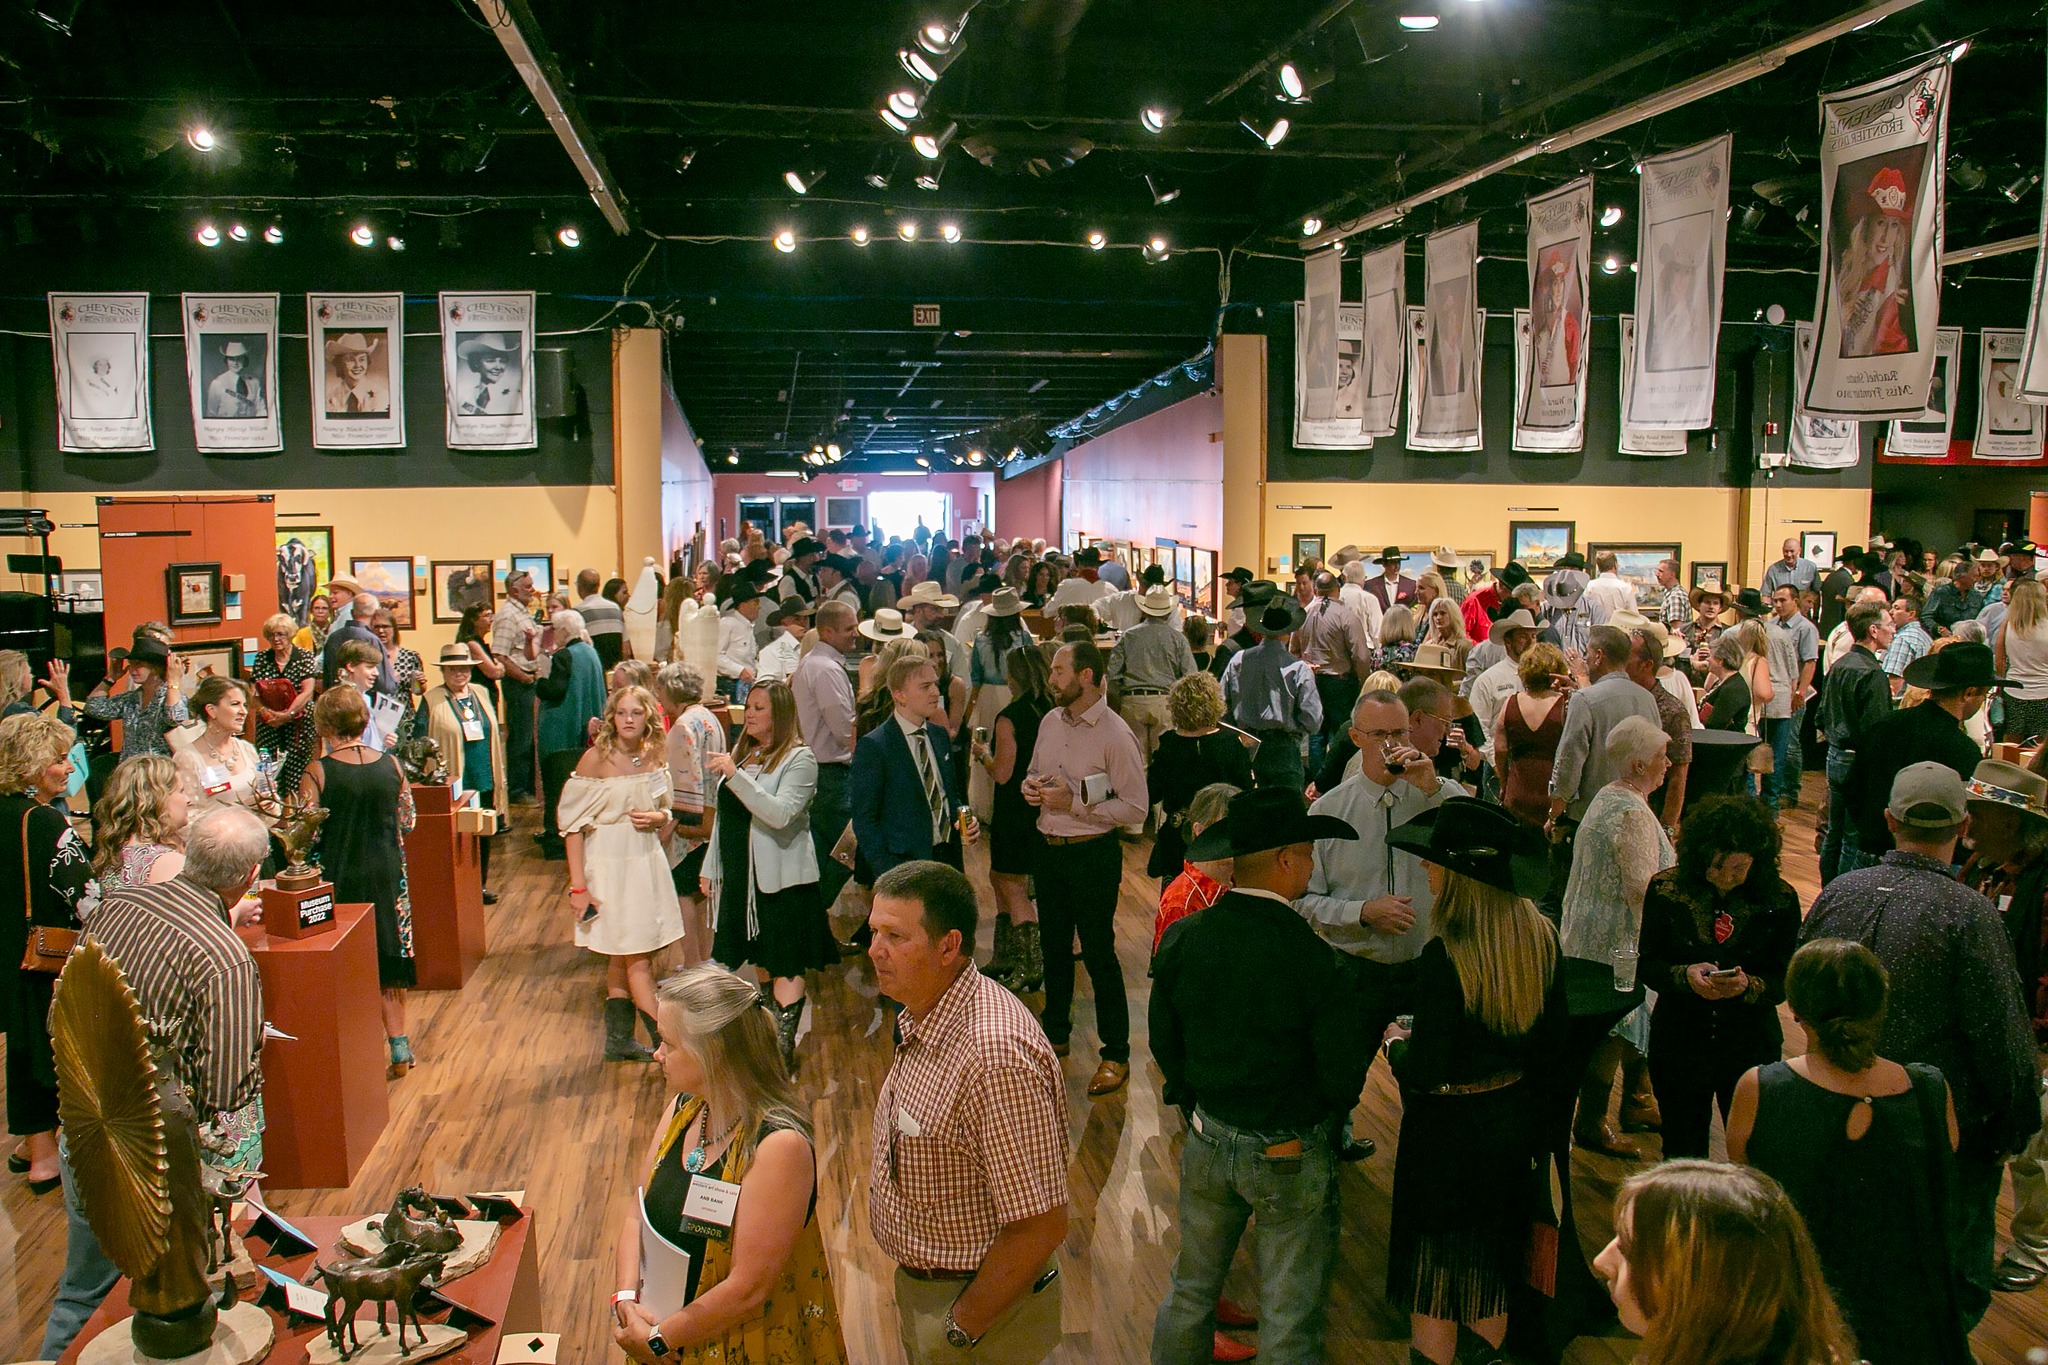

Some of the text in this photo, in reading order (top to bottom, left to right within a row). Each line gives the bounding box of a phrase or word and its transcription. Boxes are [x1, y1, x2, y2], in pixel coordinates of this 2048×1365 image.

[78, 303, 140, 316] CHEYENNE
[210, 304, 272, 317] CHEYENNE
[334, 301, 396, 314] CHEYENNE
[466, 302, 527, 315] CHEYENNE
[915, 307, 939, 324] EXIT
[300, 894, 331, 910] Museum
[300, 902, 333, 919] Purchase
[307, 911, 327, 925] 2022
[686, 1222, 722, 1238] SPONSOR
